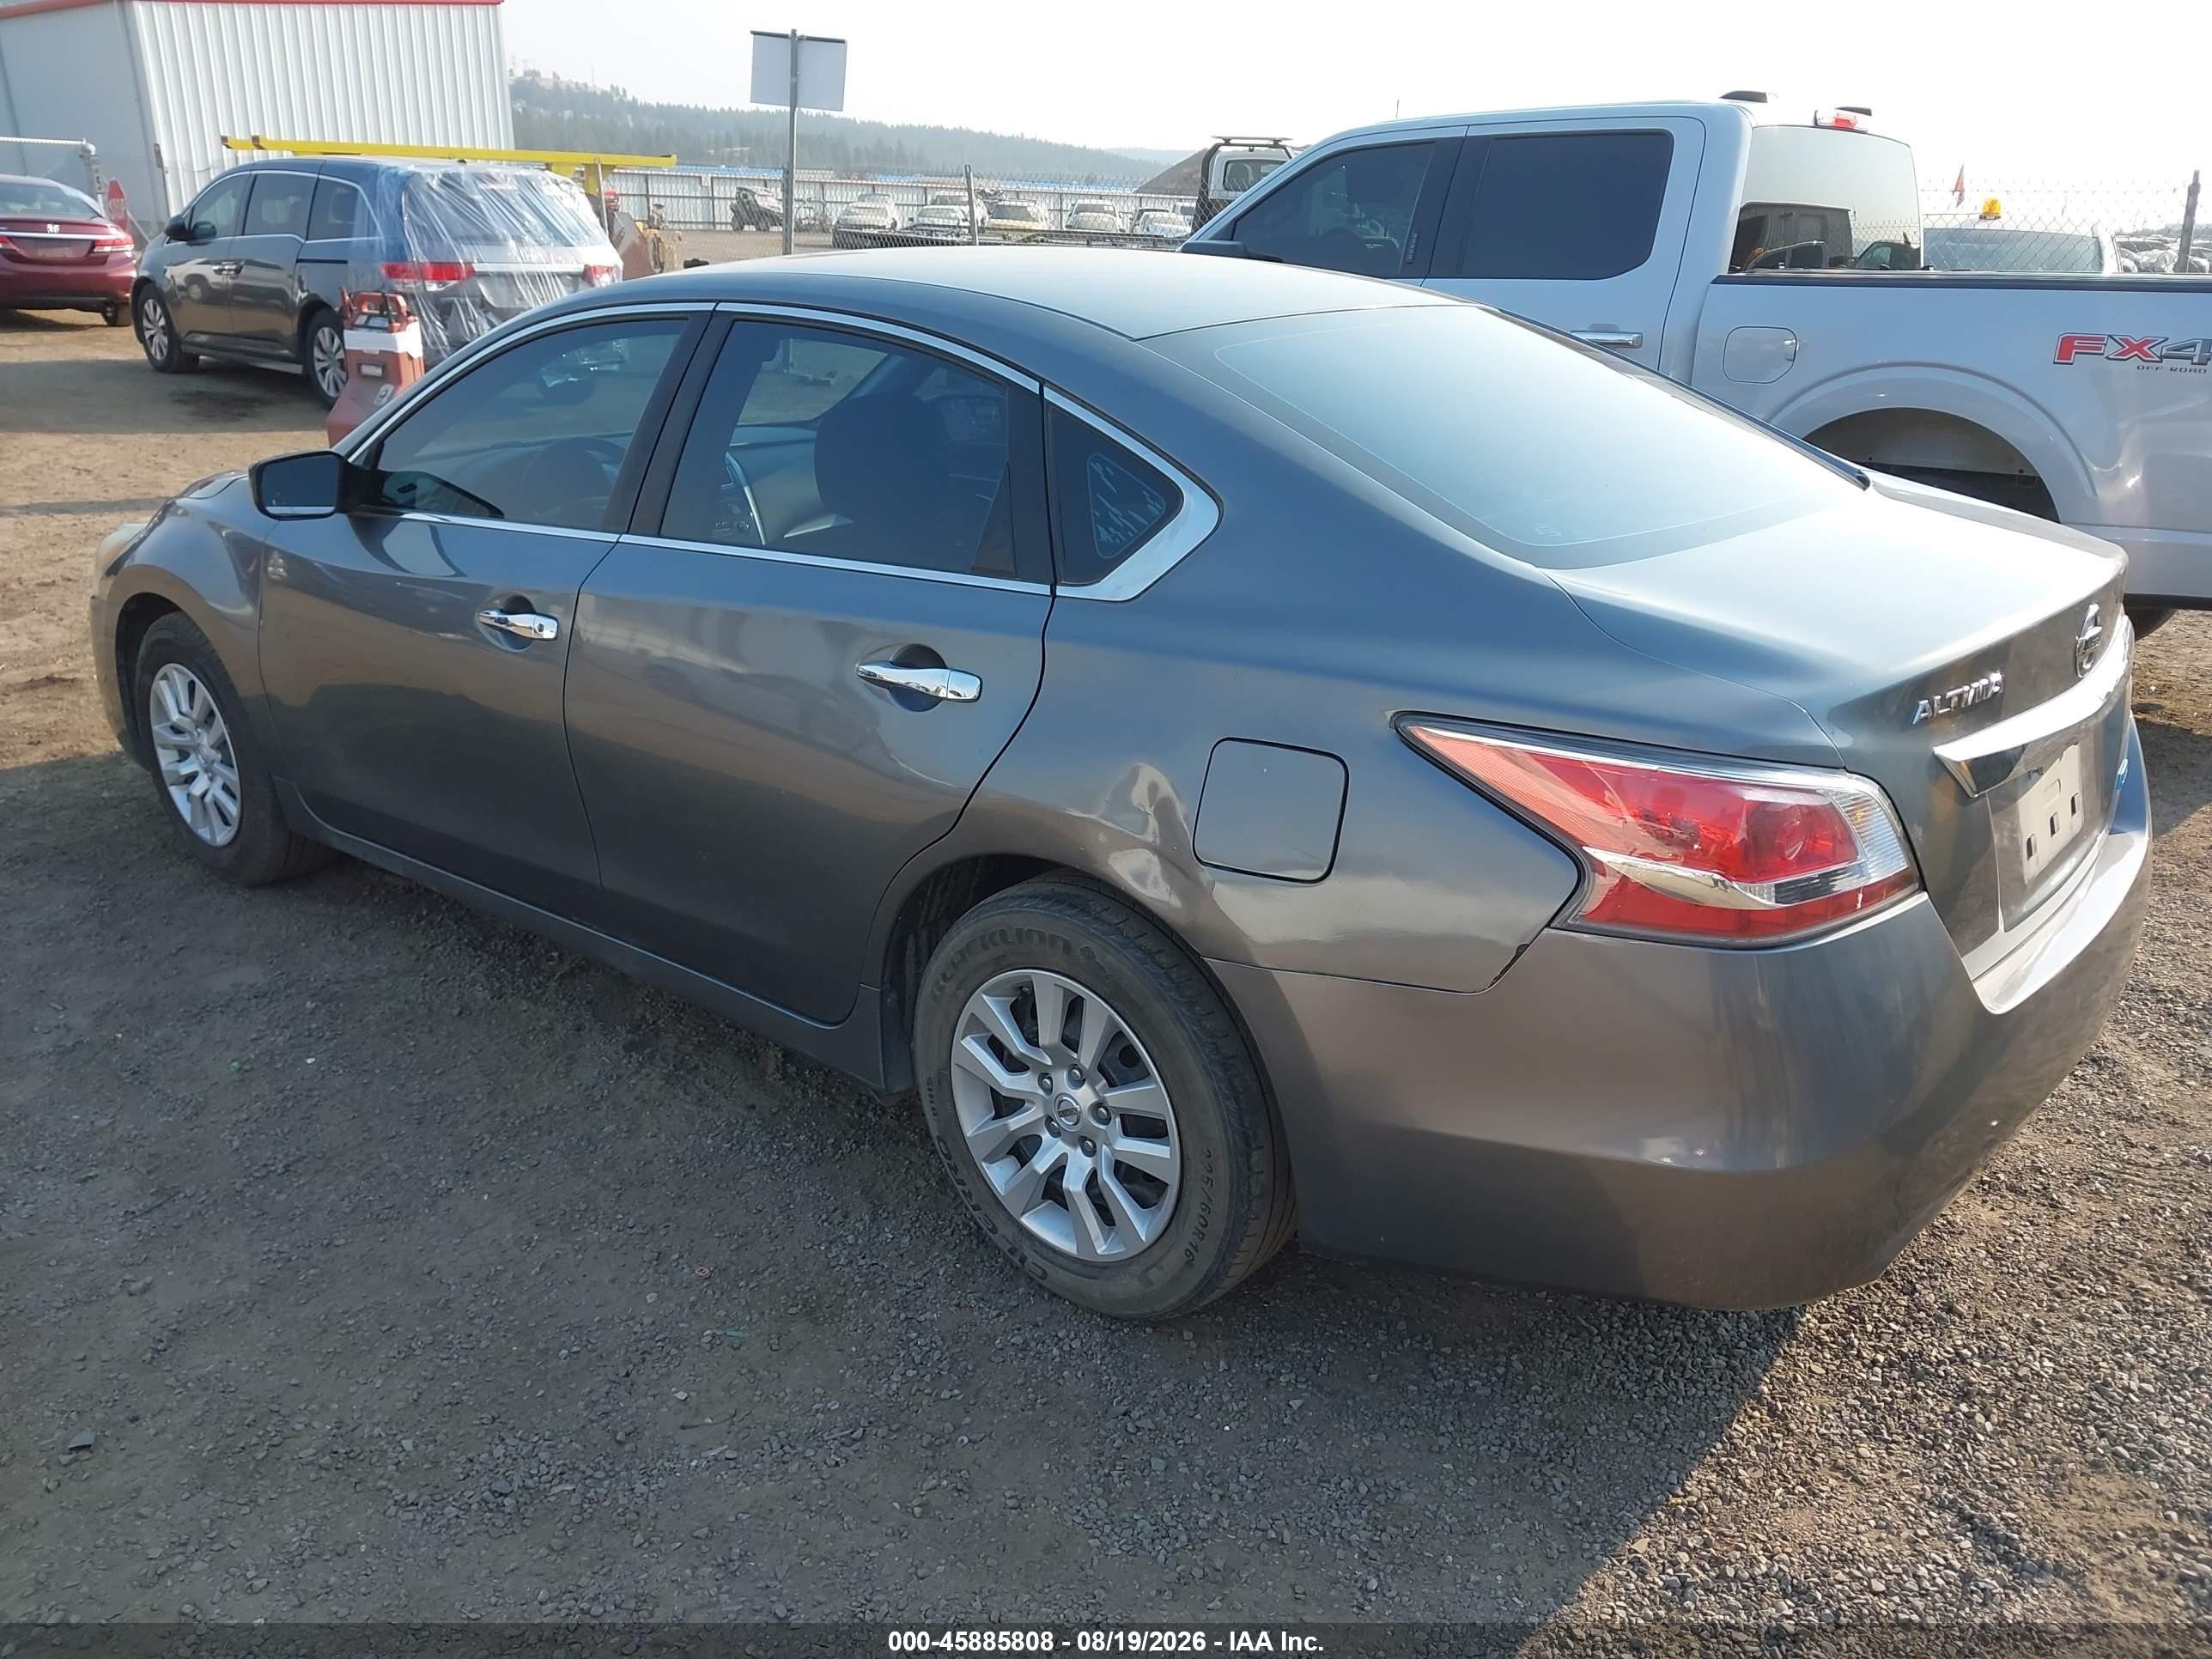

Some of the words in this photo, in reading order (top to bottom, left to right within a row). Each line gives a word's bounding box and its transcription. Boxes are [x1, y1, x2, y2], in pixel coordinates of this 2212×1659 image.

[2053, 332, 2212, 366] FX4
[1911, 671, 2004, 725] ALTIMA
[1184, 1147, 1216, 1262] 225/60R16
